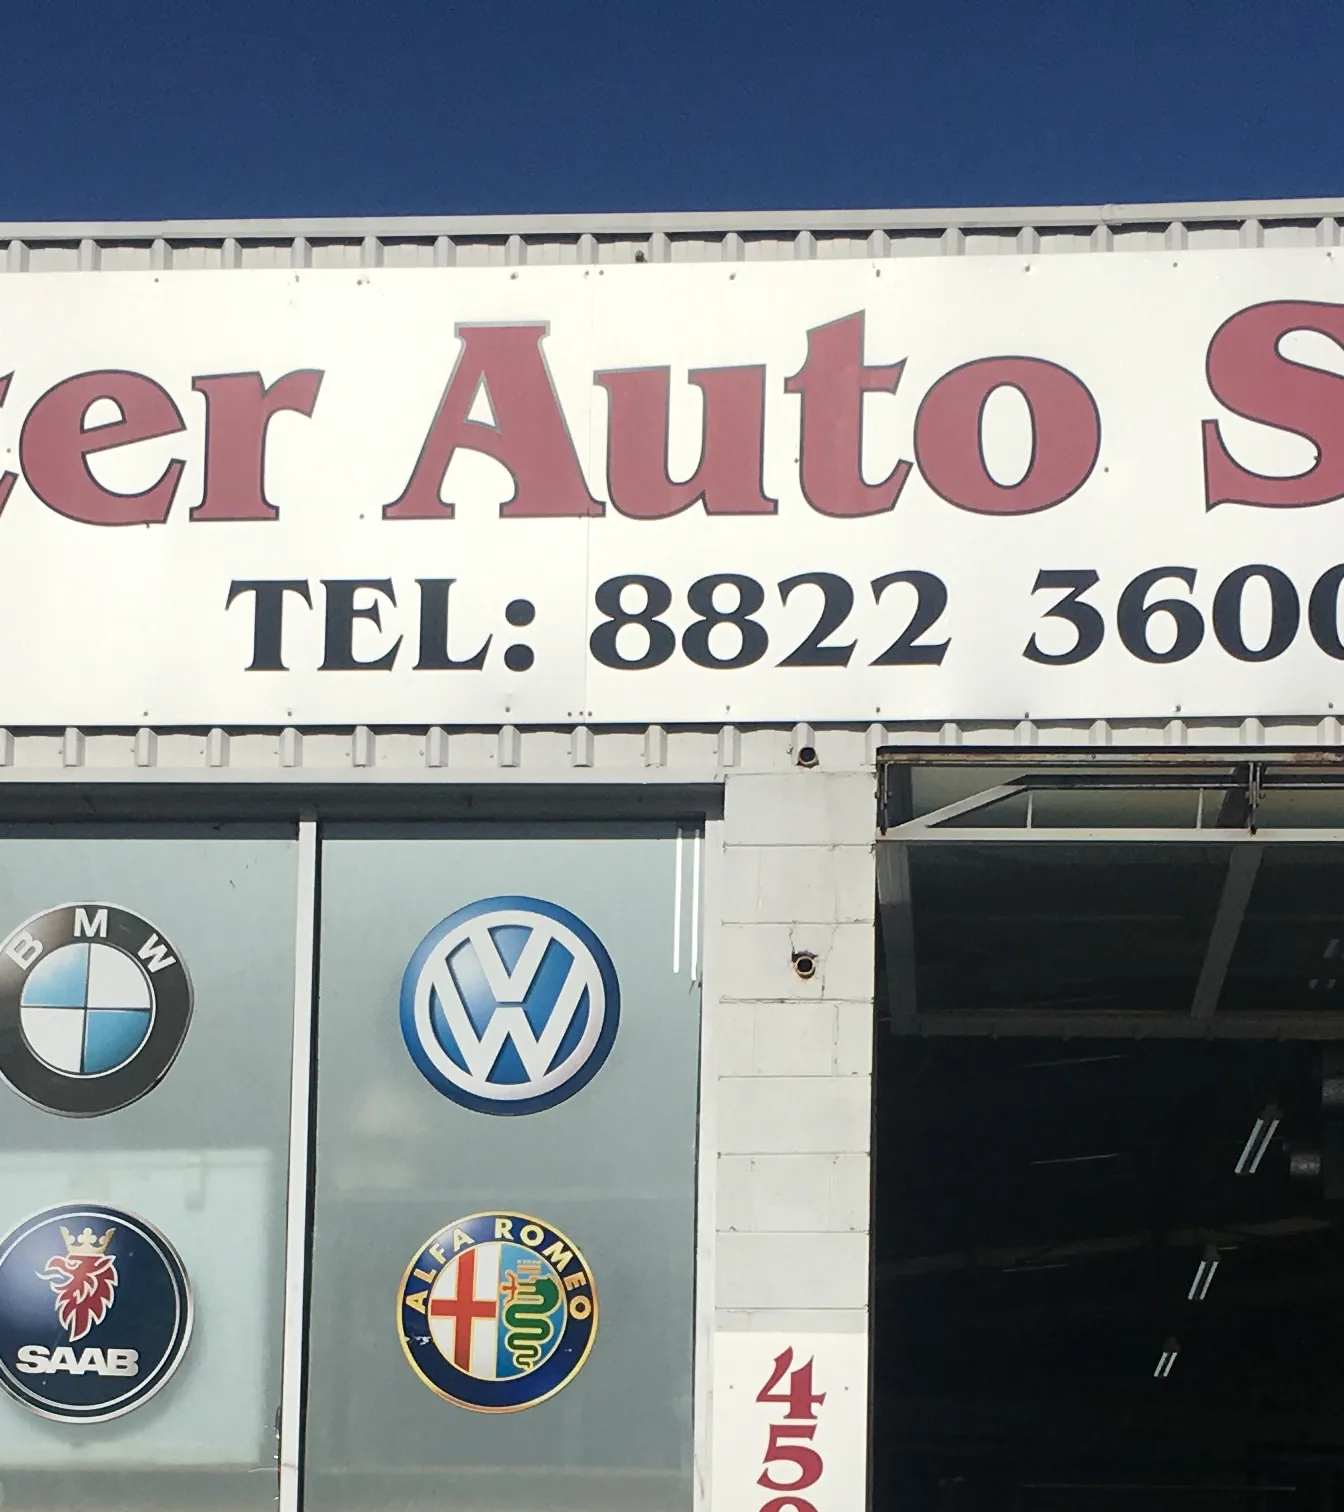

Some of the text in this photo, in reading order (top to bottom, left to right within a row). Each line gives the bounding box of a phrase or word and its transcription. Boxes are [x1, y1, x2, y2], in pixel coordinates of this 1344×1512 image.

[381, 309, 1102, 522] Auto
[225, 577, 538, 673] TEL:
[589, 569, 952, 671] 8822
[6, 908, 176, 973] BMW
[406, 1218, 592, 1320] ALFA ROMEO
[15, 1345, 139, 1377] SAAB
